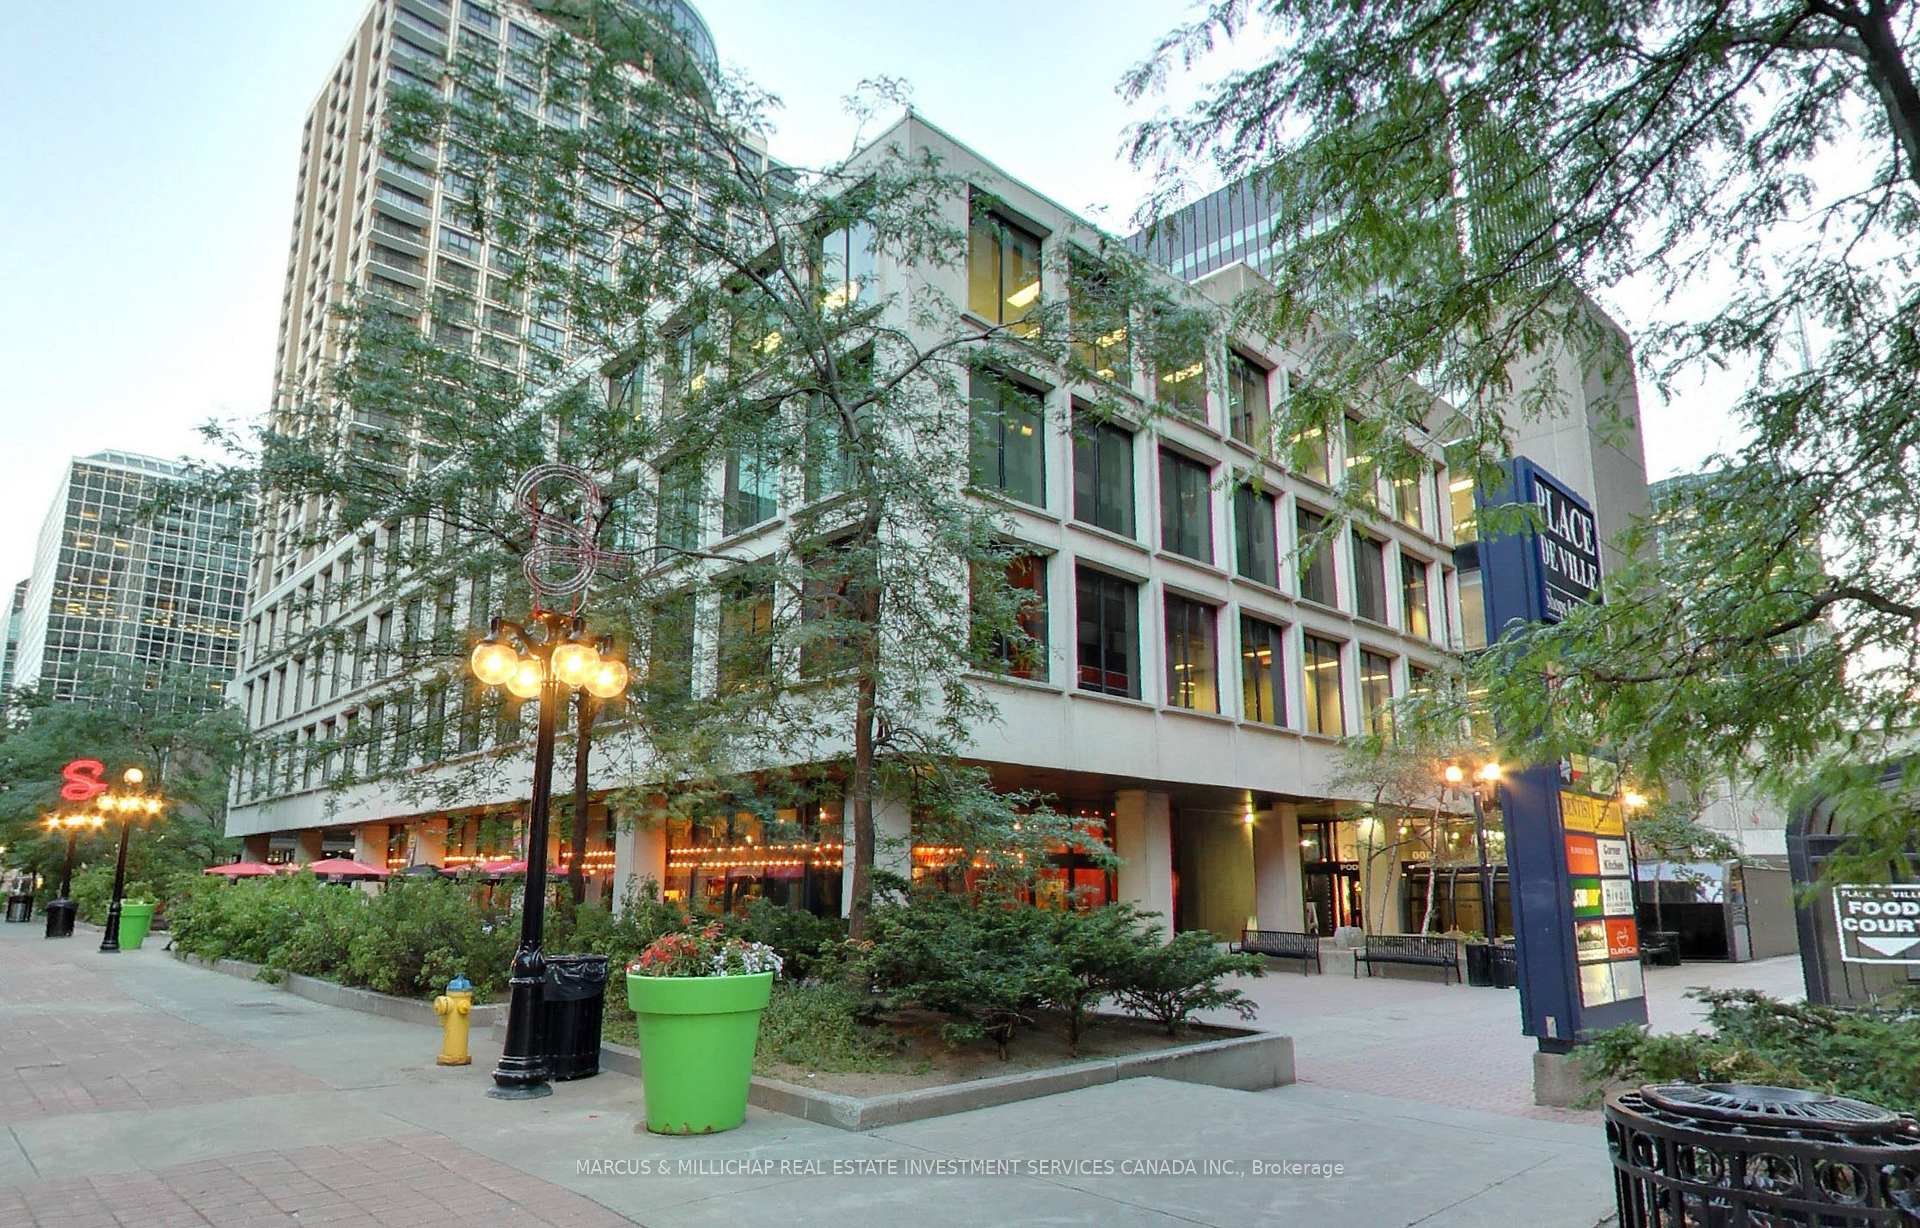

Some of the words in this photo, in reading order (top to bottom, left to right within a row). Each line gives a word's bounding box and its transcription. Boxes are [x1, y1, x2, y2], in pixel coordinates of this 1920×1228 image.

[1535, 481, 1596, 556] PLACE
[1540, 534, 1559, 572] DE
[1559, 546, 1598, 591] VILLE
[1848, 901, 1920, 915] FOOD
[1891, 891, 1920, 899] VILL
